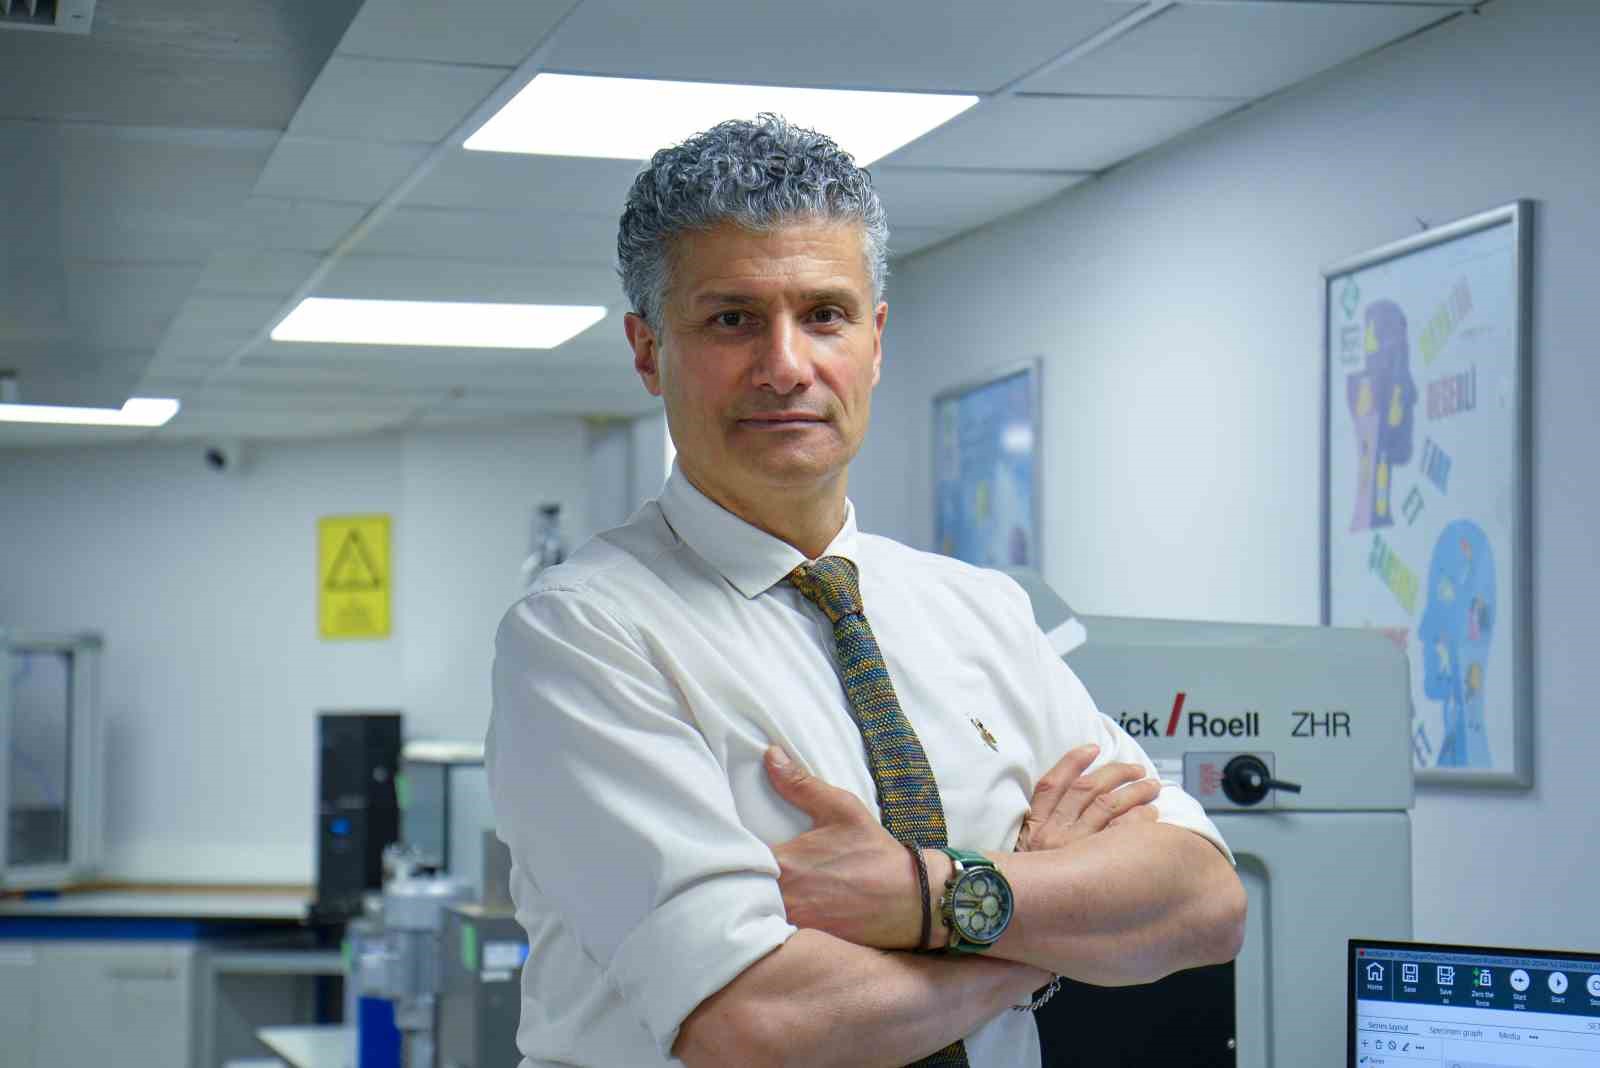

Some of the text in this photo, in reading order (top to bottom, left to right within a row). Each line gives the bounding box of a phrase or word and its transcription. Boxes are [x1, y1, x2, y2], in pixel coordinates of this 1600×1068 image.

[1112, 712, 1259, 738] ick Roell
[1291, 712, 1351, 738] ZHR
[1462, 1027, 1483, 1039] graph
[1498, 1030, 1521, 1041] Media
